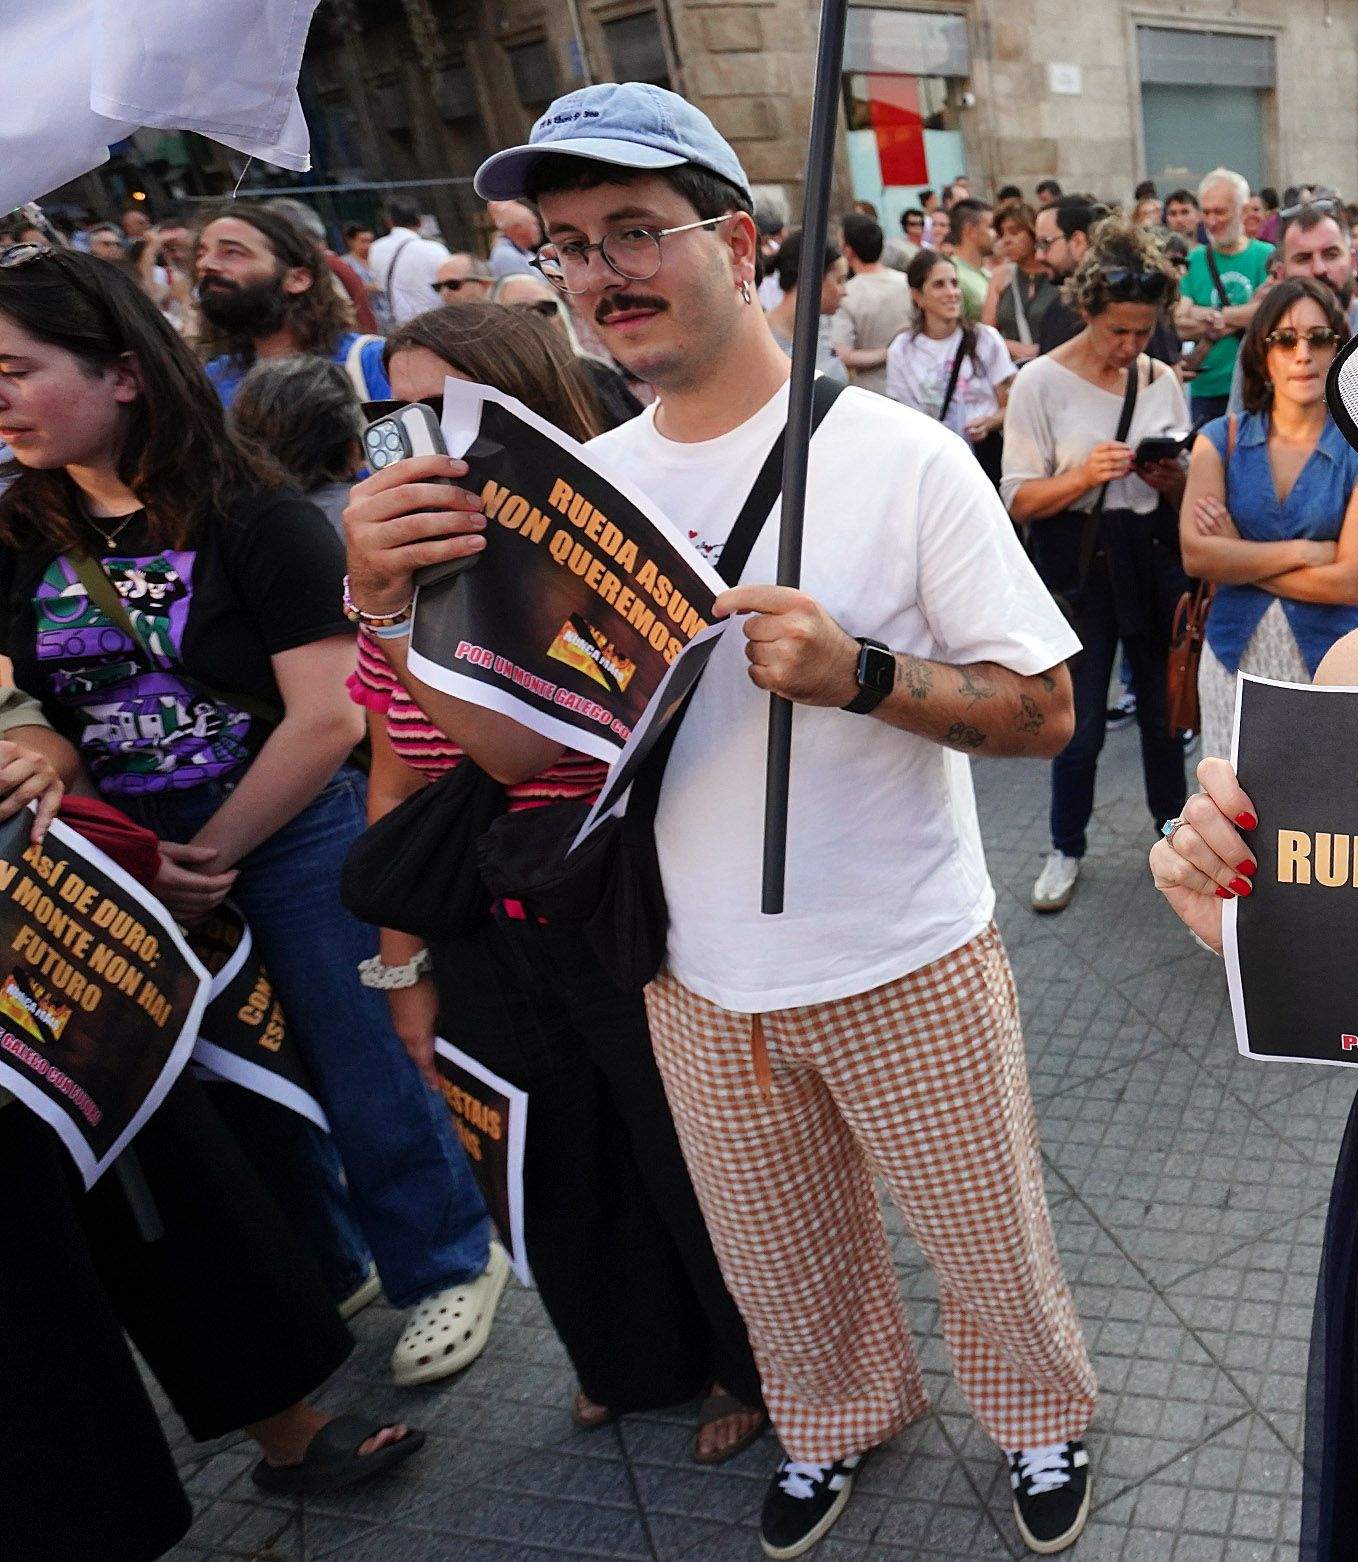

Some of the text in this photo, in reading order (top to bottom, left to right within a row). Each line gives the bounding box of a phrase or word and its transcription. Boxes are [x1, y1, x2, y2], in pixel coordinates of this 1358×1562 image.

[481, 479, 683, 666] NON QUEREMOS
[548, 478, 639, 573] RUEDA
[454, 640, 495, 669] POR
[493, 655, 514, 679] UN
[512, 664, 557, 700] MONTE
[554, 687, 613, 725] GALEGO
[11, 876, 95, 959] MONTE
[88, 943, 144, 996] NON
[137, 981, 173, 1028] HAI
[59, 873, 99, 914] DE
[91, 899, 161, 968] DURO:
[11, 925, 102, 1012] FUTURO
